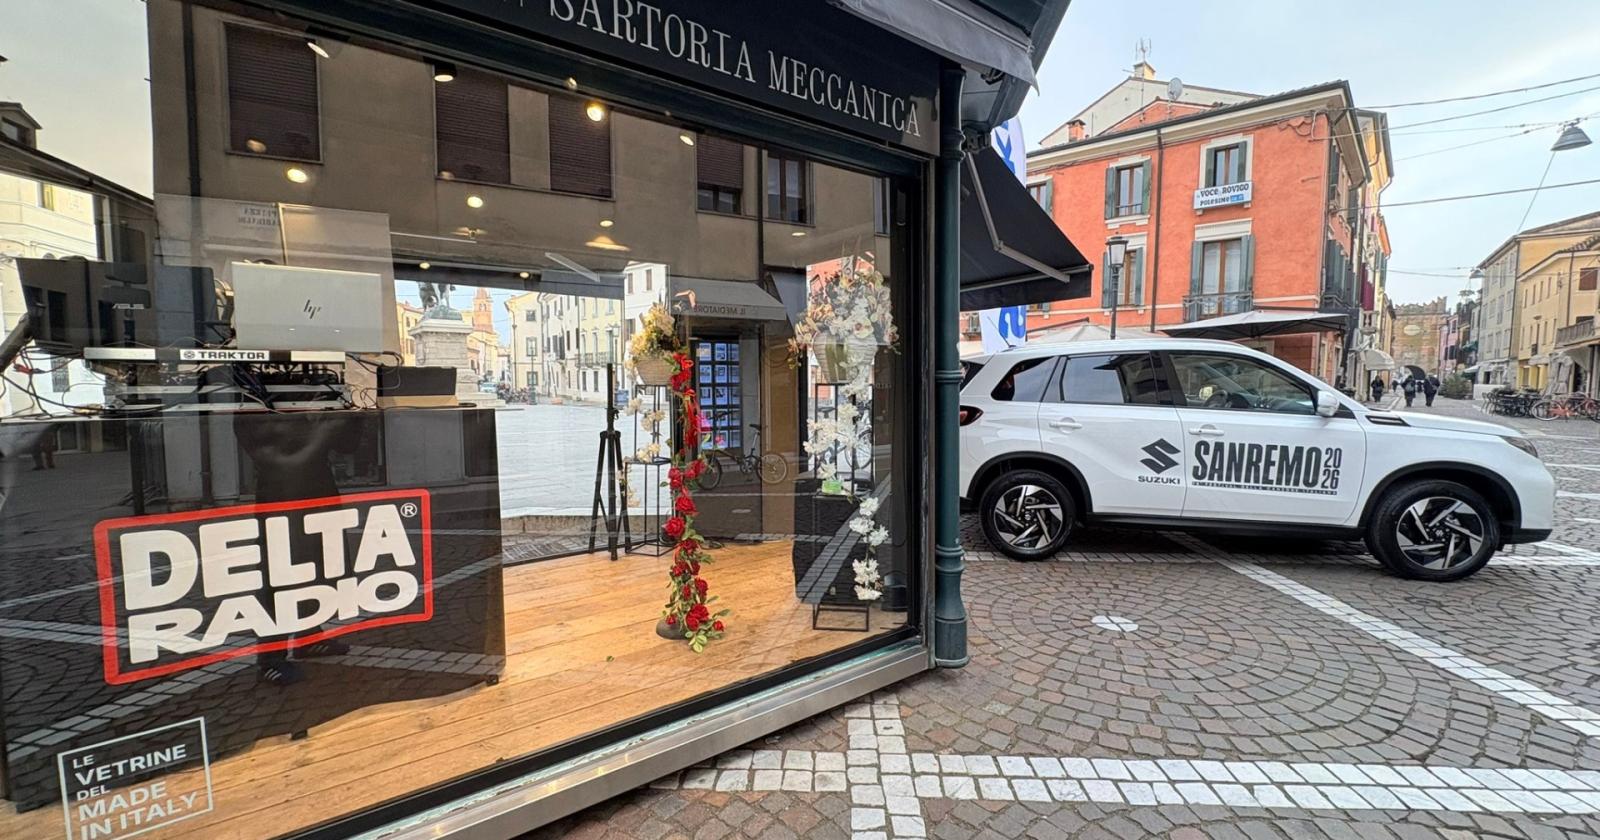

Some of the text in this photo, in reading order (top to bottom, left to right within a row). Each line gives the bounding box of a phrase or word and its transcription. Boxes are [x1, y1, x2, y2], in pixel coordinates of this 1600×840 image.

[767, 50, 921, 137] MECCANICA
[200, 351, 266, 361] TRAKTOR
[1192, 440, 1322, 488] SANREMO
[1323, 447, 1342, 469] 20
[1138, 475, 1181, 485] SUZUKI
[1320, 468, 1340, 490] 26
[120, 504, 416, 610] DELTA
[128, 570, 419, 664] RADIO
[72, 754, 95, 769] LE
[75, 744, 187, 786] VETRINE
[76, 785, 111, 801] DEL
[79, 781, 168, 822] MADE
[80, 792, 198, 840] IN ITALY
